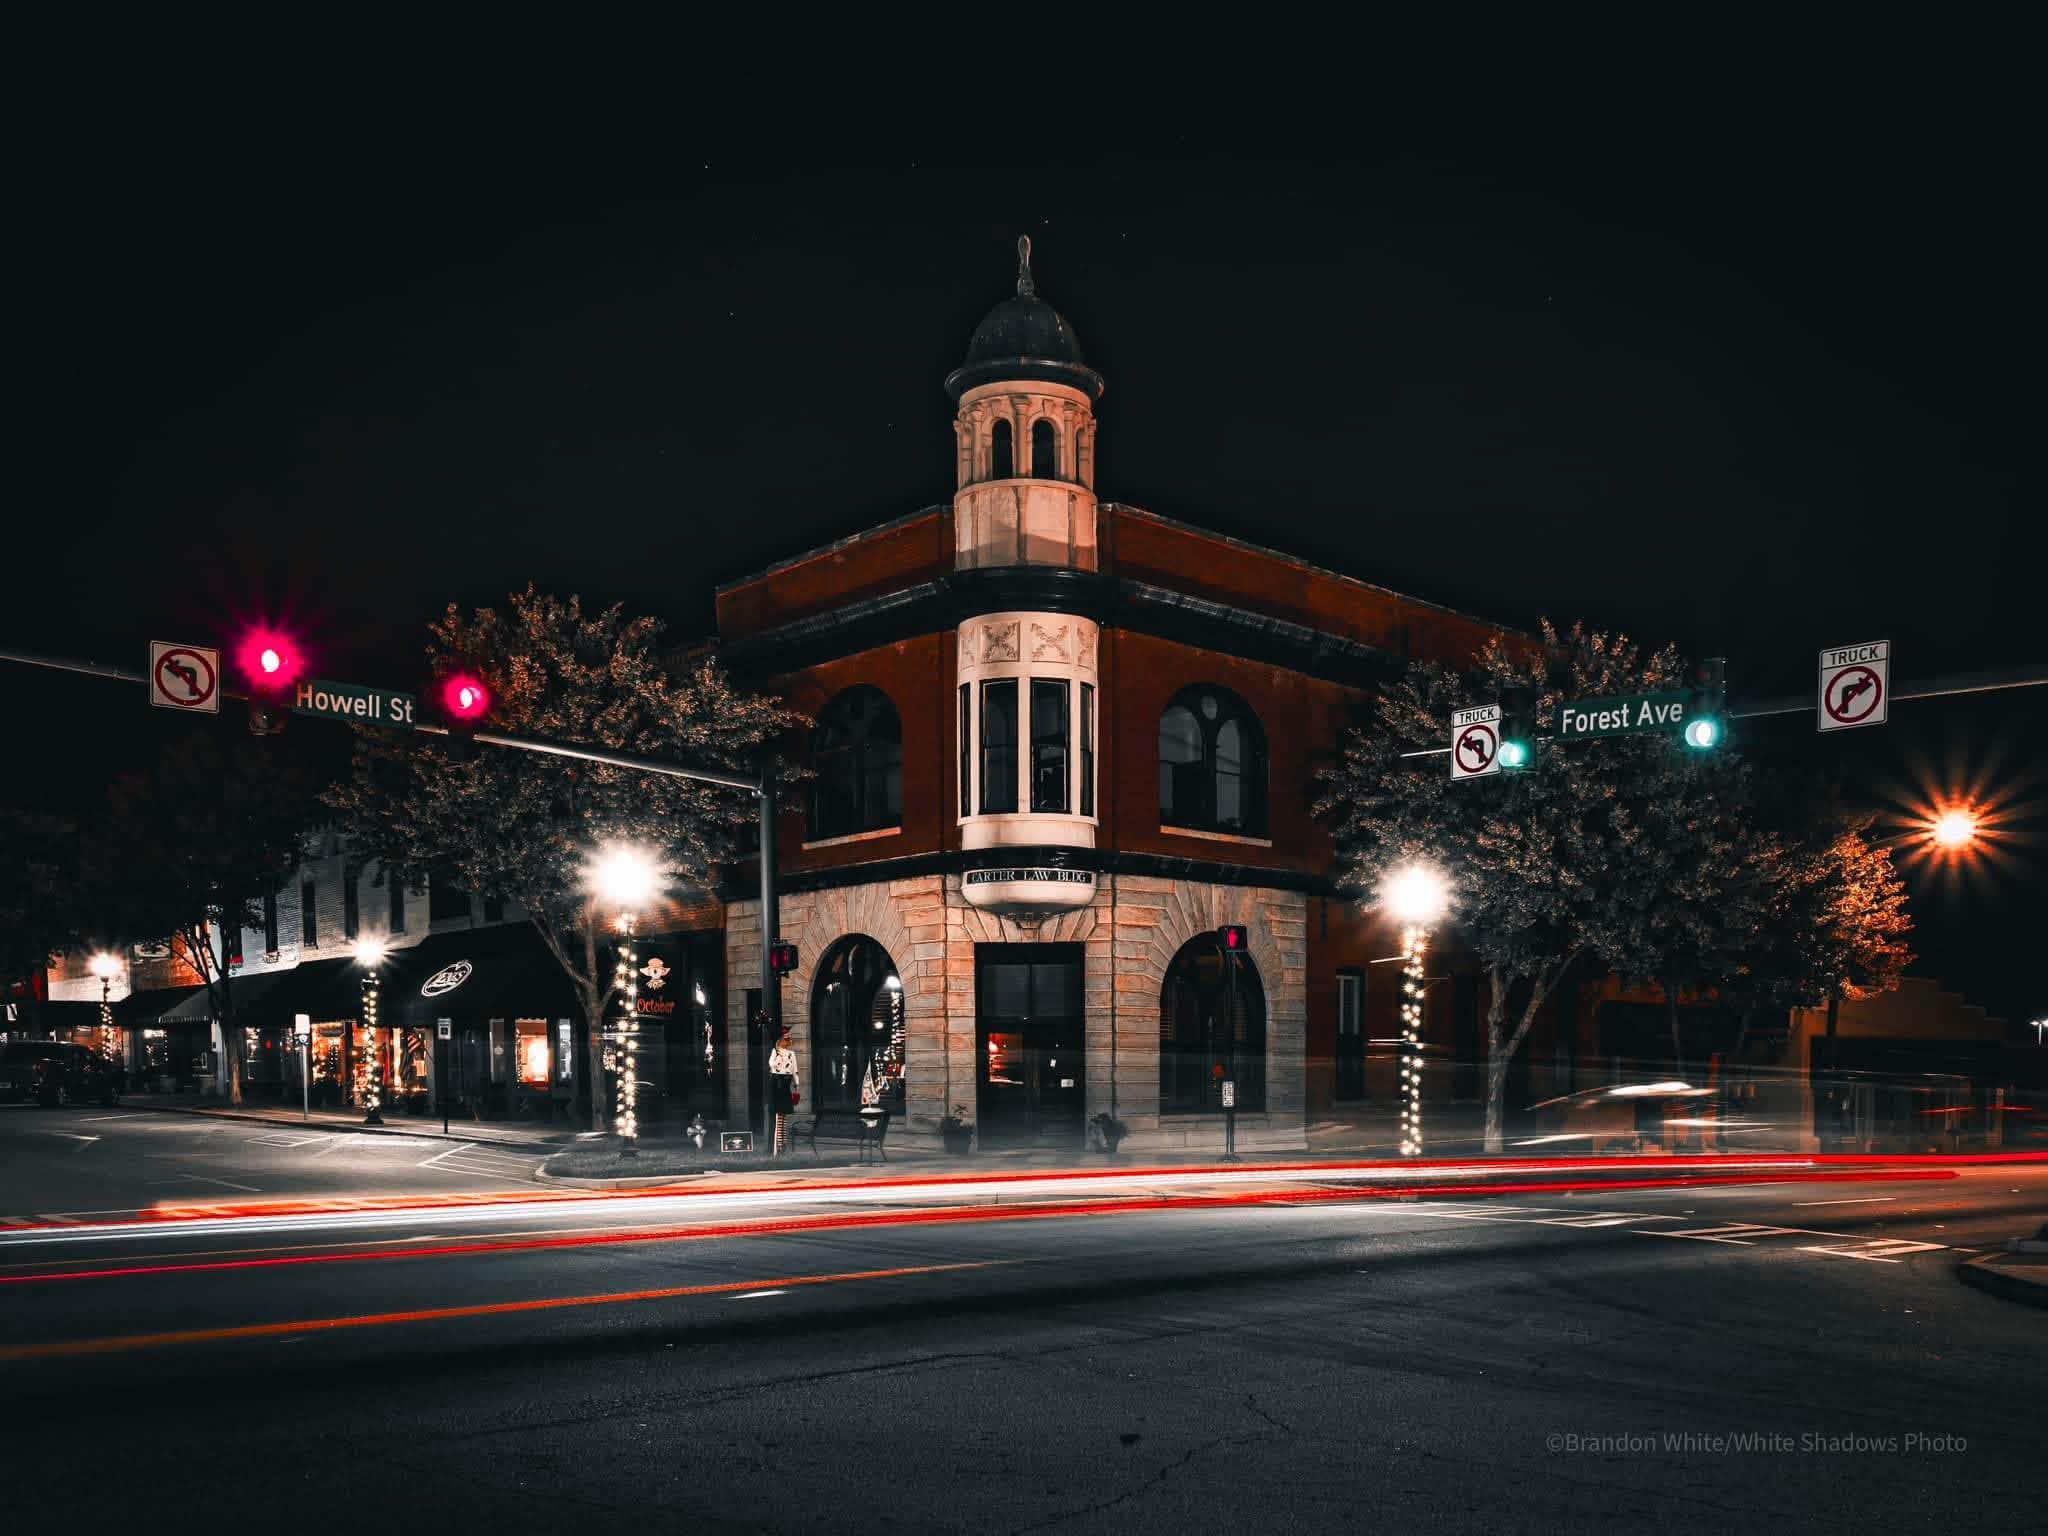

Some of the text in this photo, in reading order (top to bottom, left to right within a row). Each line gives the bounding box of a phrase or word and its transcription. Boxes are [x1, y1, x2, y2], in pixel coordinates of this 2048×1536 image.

[1829, 646, 1878, 665] TRUCK
[296, 683, 412, 722] Howell St
[1459, 707, 1494, 724] TRUCK
[1562, 700, 1683, 733] Forest Ave
[1023, 870, 1051, 881] LAW
[1057, 871, 1086, 882] BLDG
